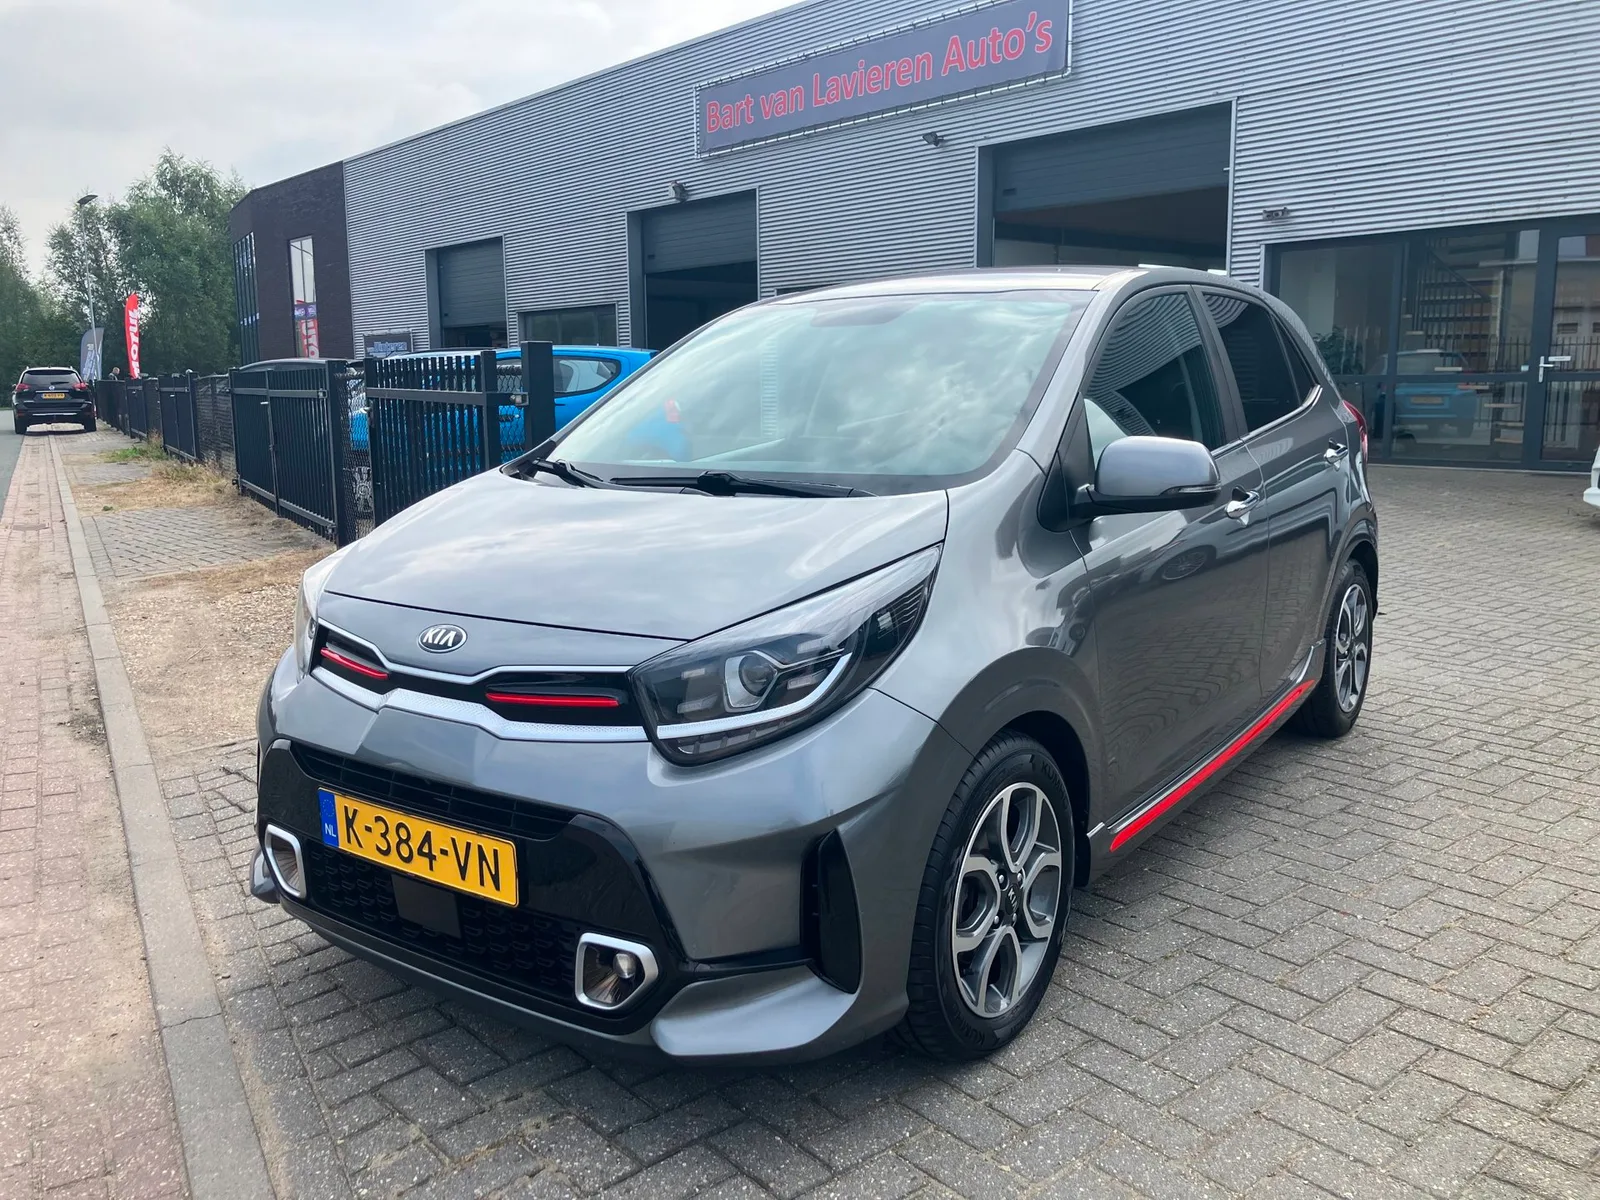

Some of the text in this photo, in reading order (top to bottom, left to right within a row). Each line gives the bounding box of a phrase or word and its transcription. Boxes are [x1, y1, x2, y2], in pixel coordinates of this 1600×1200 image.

[706, 11, 1053, 134] Bart van Lavieren Auto's
[128, 308, 140, 378] MOTUL
[422, 628, 457, 647] KIA
[324, 822, 337, 838] NL
[344, 804, 501, 892] K-384-VN
